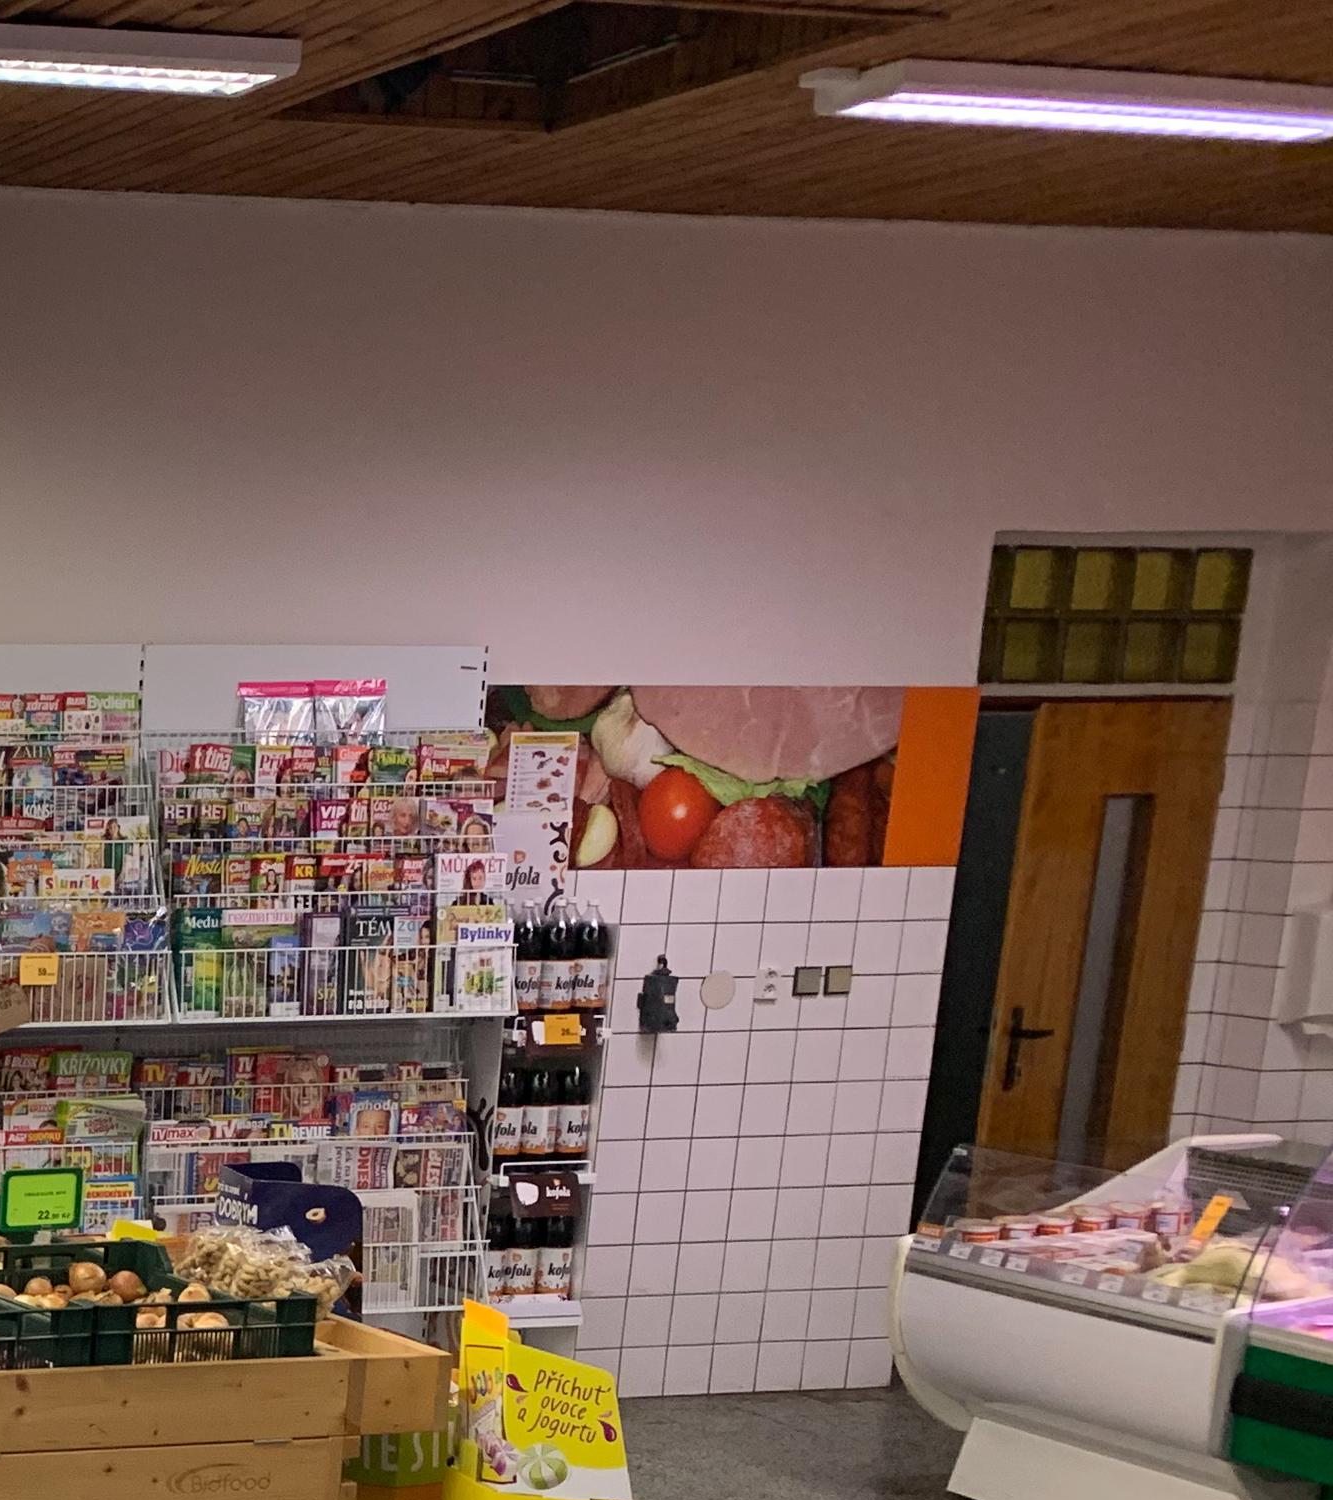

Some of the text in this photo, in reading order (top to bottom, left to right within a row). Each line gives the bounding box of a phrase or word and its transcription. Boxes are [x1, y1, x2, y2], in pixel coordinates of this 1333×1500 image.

[320, 805, 346, 818] VIP
[459, 926, 512, 942] Bylinky
[143, 1064, 165, 1082] TV
[546, 1185, 571, 1200] kofola
[540, 1394, 588, 1421] ovoce
[517, 1407, 598, 1445] a jogurtu
[192, 1471, 273, 1495] Bidfood
